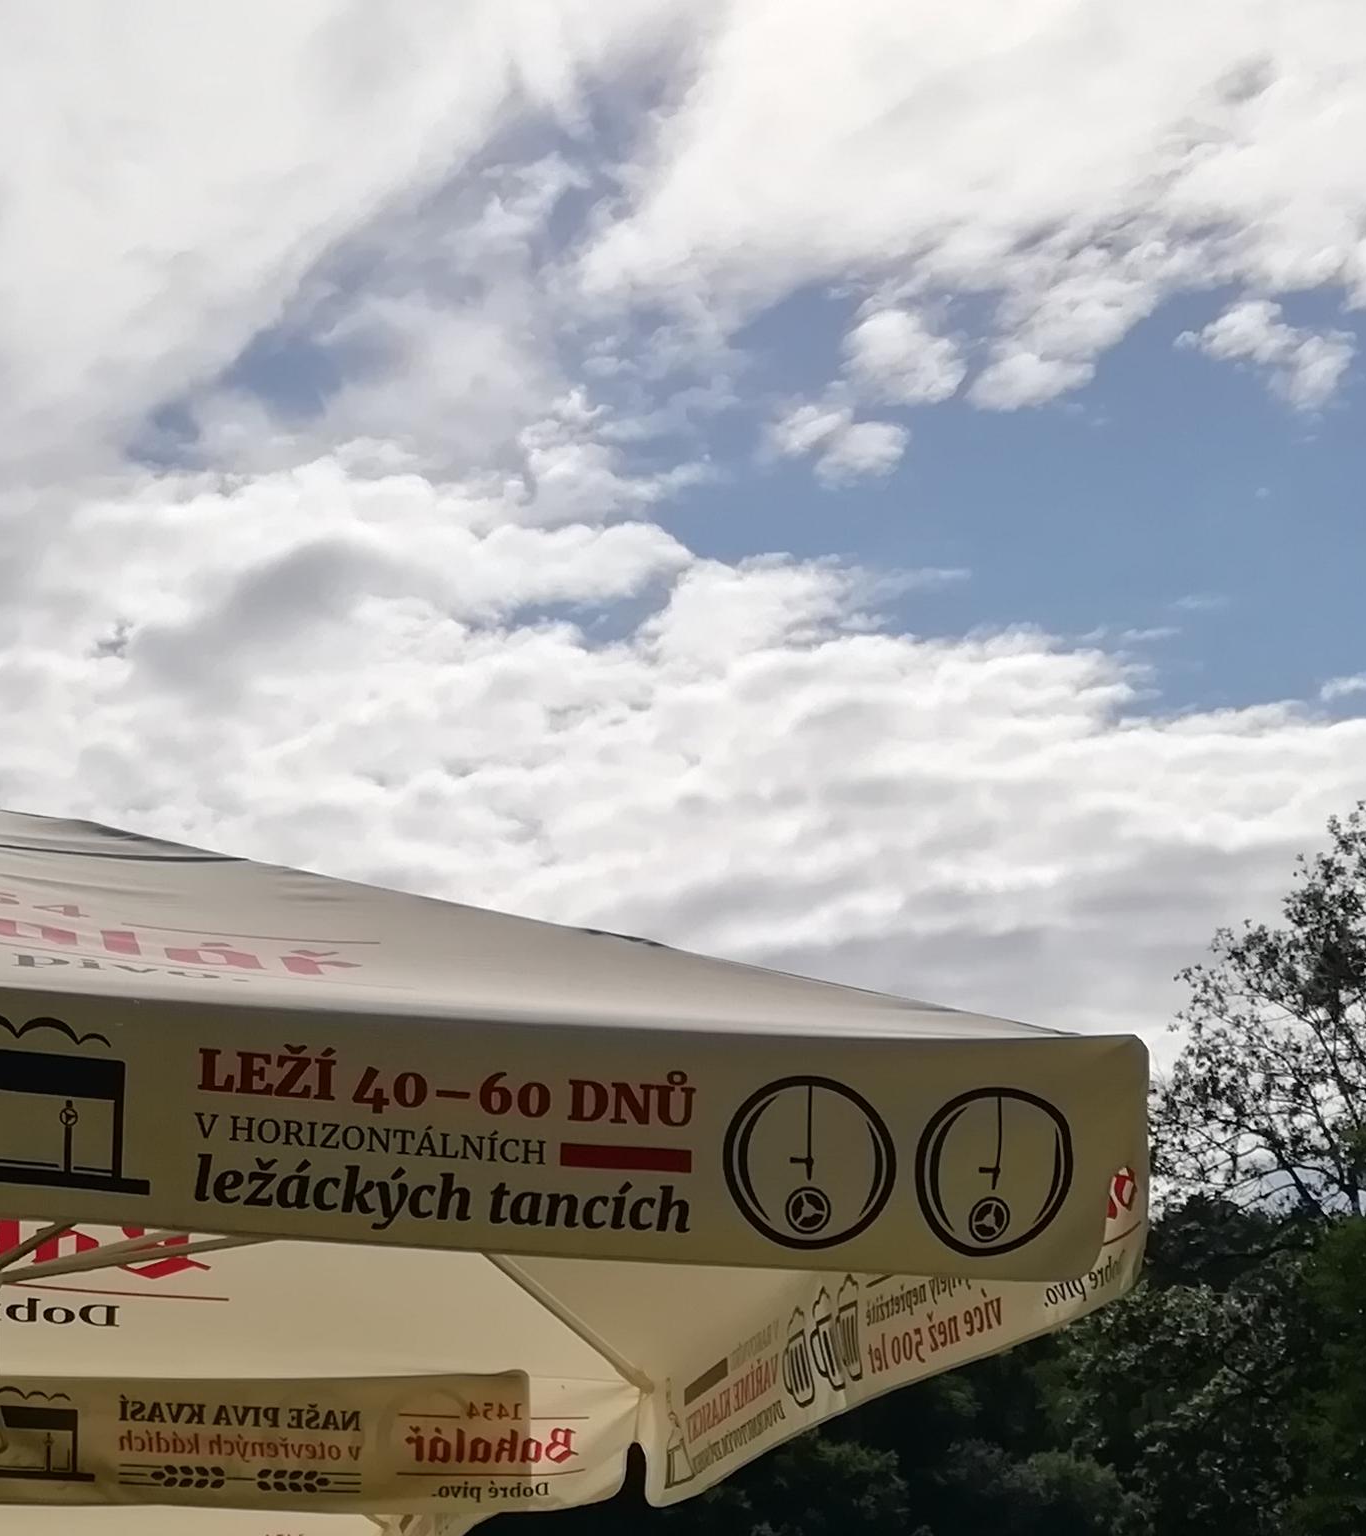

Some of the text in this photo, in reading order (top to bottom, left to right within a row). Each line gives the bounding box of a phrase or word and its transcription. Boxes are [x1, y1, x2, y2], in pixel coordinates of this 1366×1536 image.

[196, 1043, 337, 1101] LEŽÍ
[566, 1070, 696, 1127] DNŮ
[194, 1112, 546, 1165] V HORIZONTÁLNÍCH
[194, 1153, 691, 1233] ležáckých tancích
